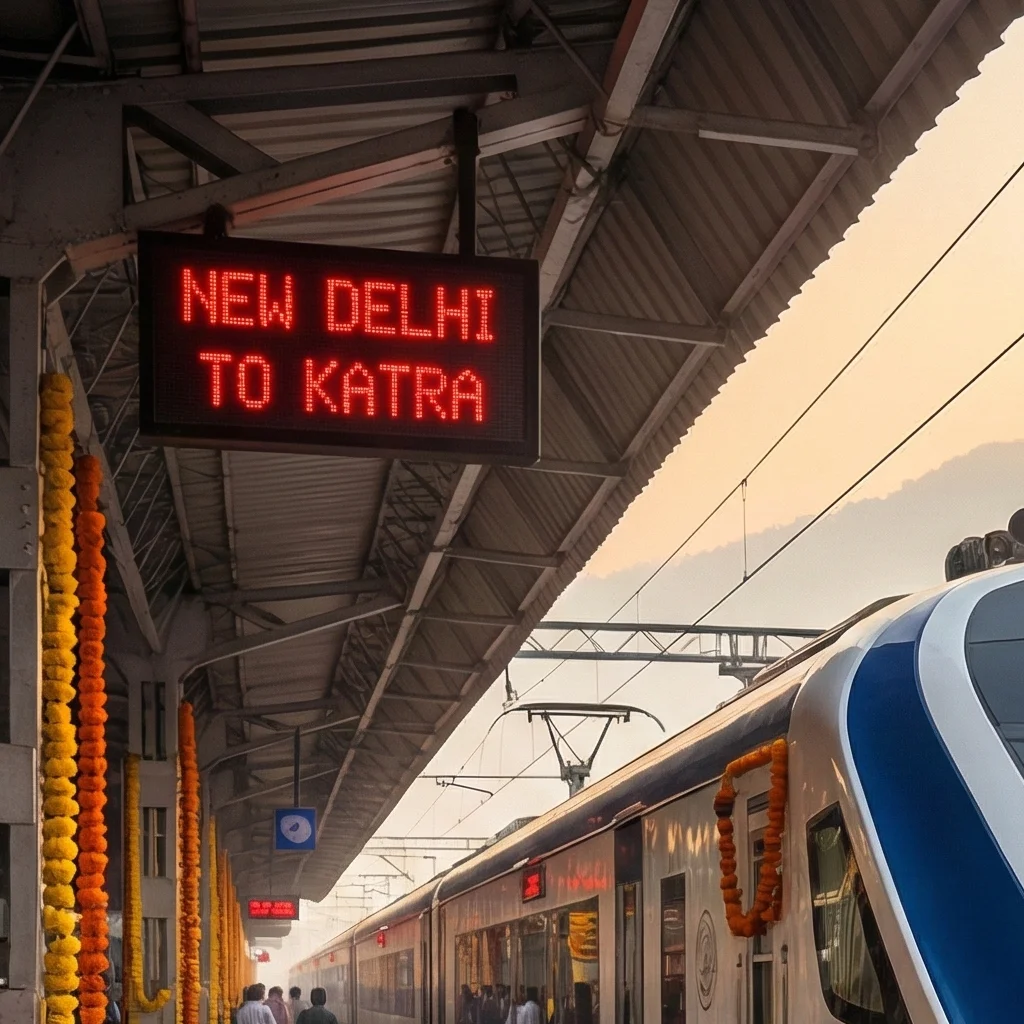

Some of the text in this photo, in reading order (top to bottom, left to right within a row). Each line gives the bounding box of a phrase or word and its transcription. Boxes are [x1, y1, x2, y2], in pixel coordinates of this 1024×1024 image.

[182, 268, 494, 342] NEW DELHI
[199, 352, 483, 422] TO KATRA
